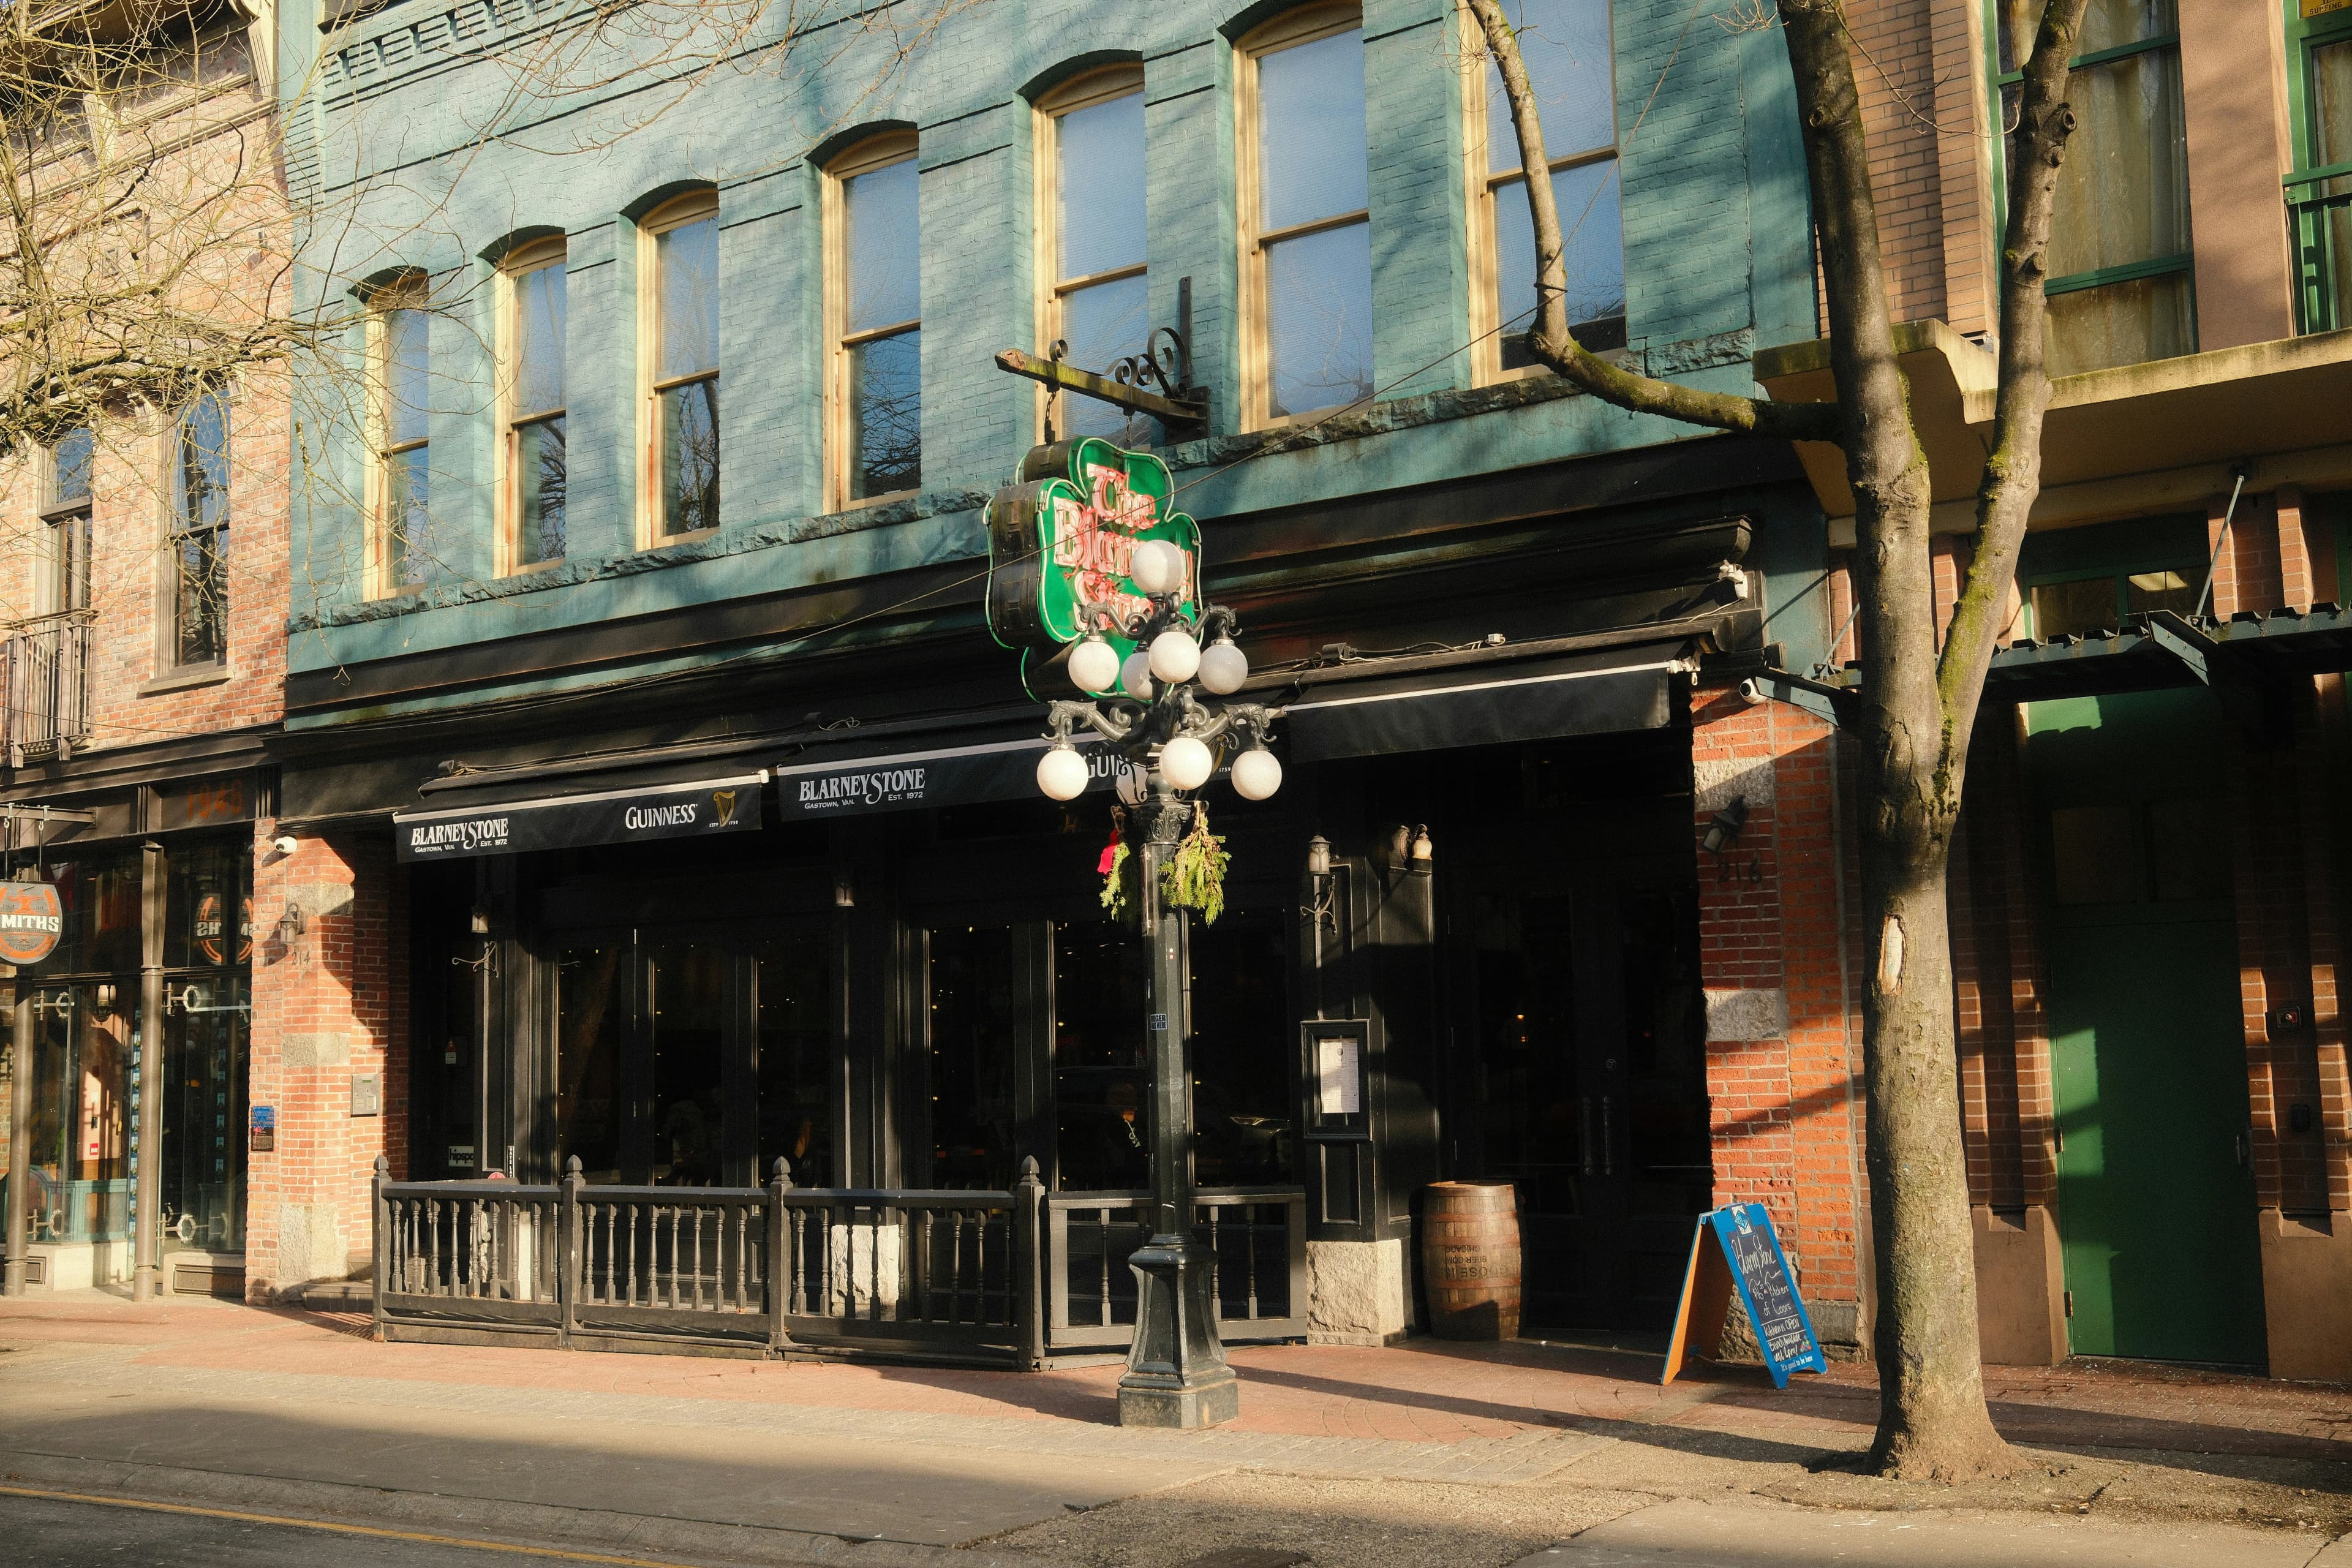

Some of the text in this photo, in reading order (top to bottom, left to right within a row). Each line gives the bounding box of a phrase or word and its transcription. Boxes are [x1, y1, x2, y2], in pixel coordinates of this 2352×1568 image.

[1087, 463, 1160, 530] The
[625, 804, 698, 829] GUINNESS
[291, 951, 311, 966] 214
[1764, 1298, 1792, 1316] of Coors
[1785, 1318, 1800, 1330] OPEN
